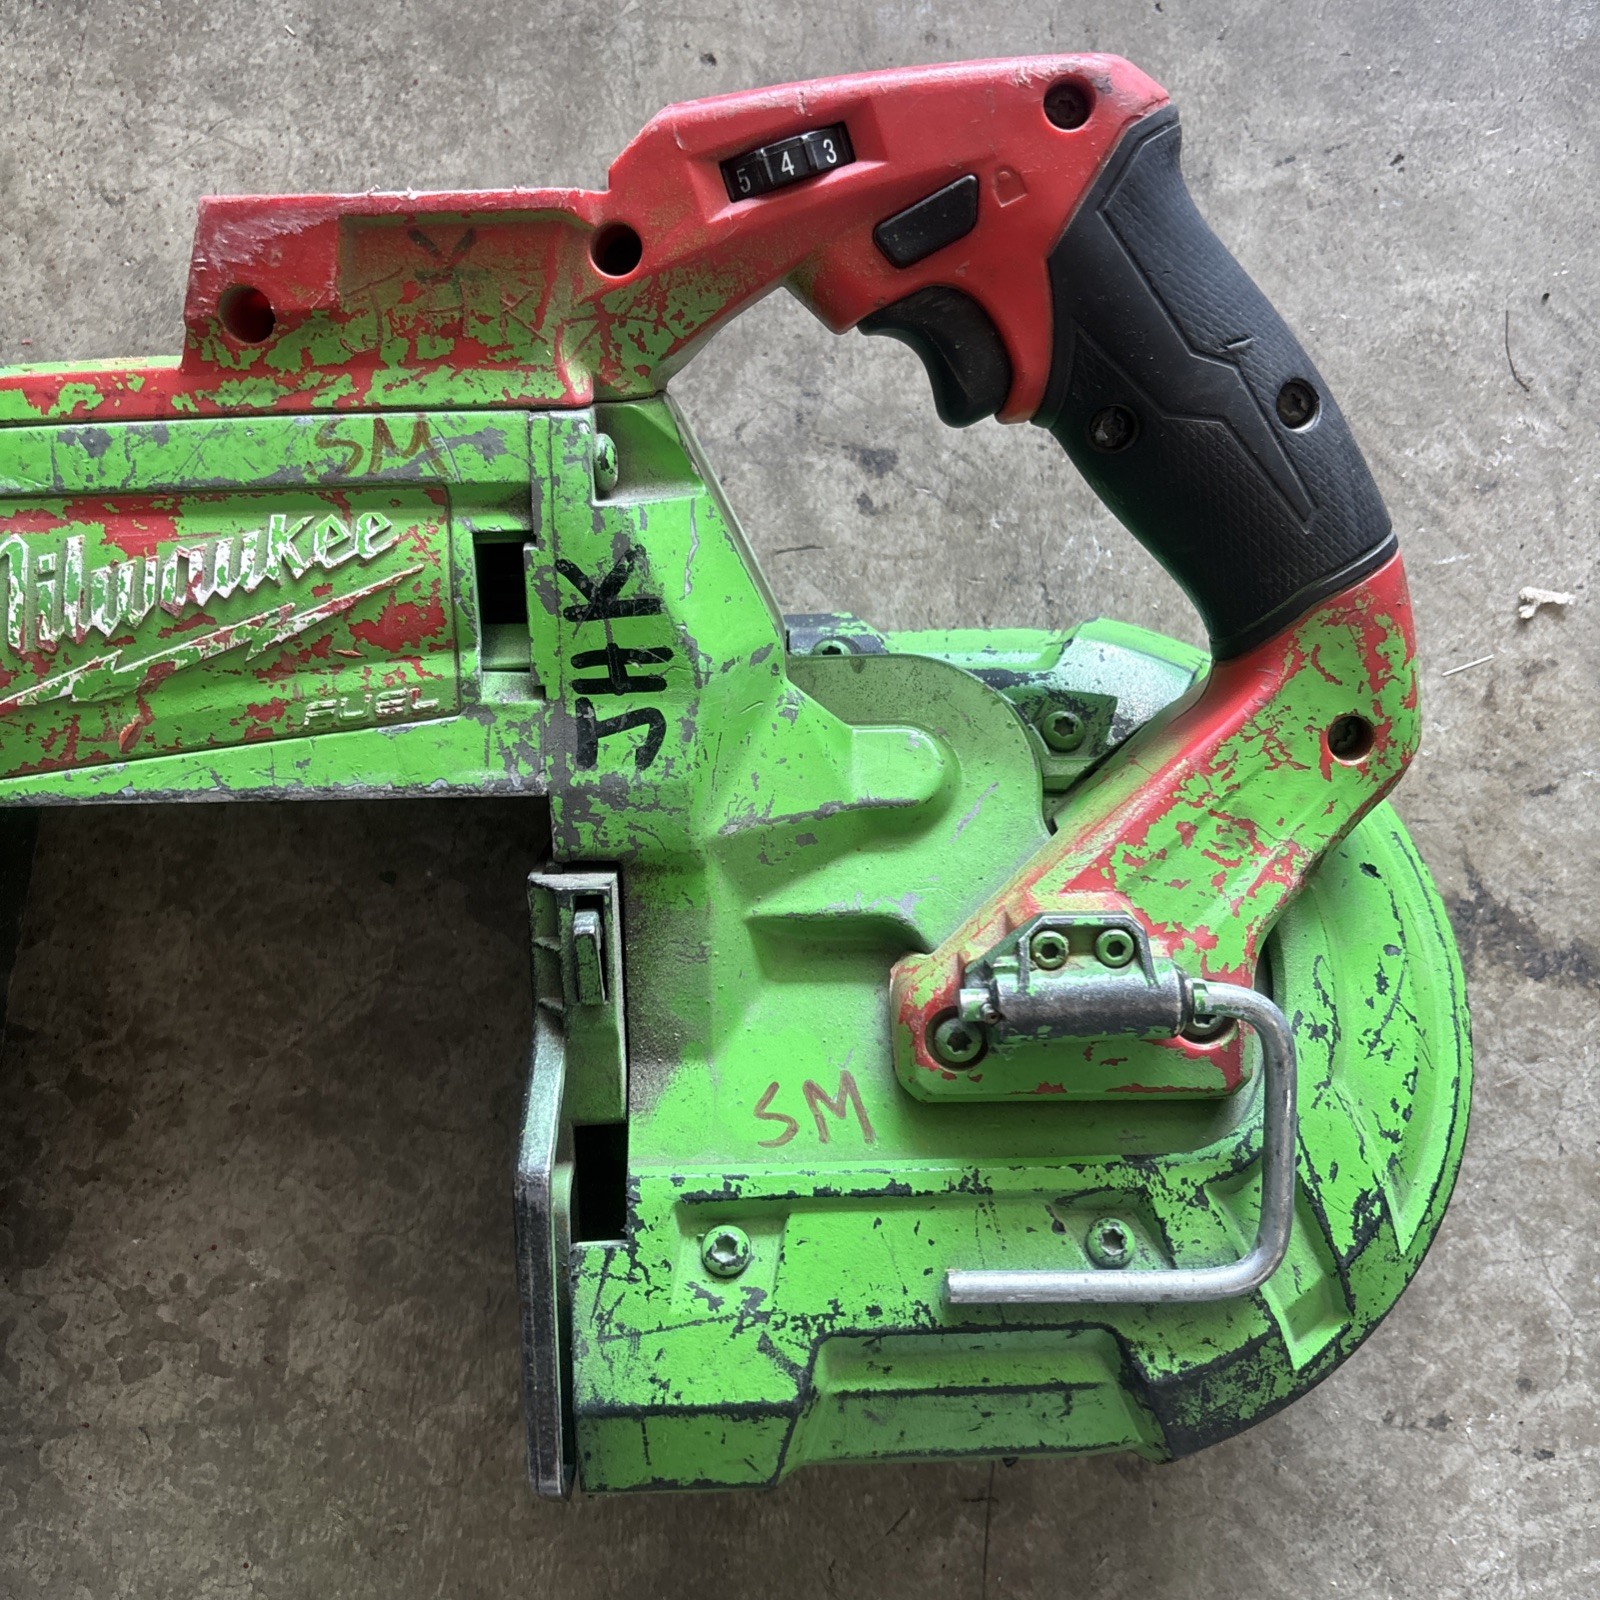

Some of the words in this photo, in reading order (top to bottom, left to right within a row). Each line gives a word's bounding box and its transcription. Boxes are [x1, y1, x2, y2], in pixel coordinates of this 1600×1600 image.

[307, 412, 451, 477] SM
[555, 544, 675, 770] JHK
[303, 686, 439, 727] FUEL
[753, 1069, 876, 1149] SM
